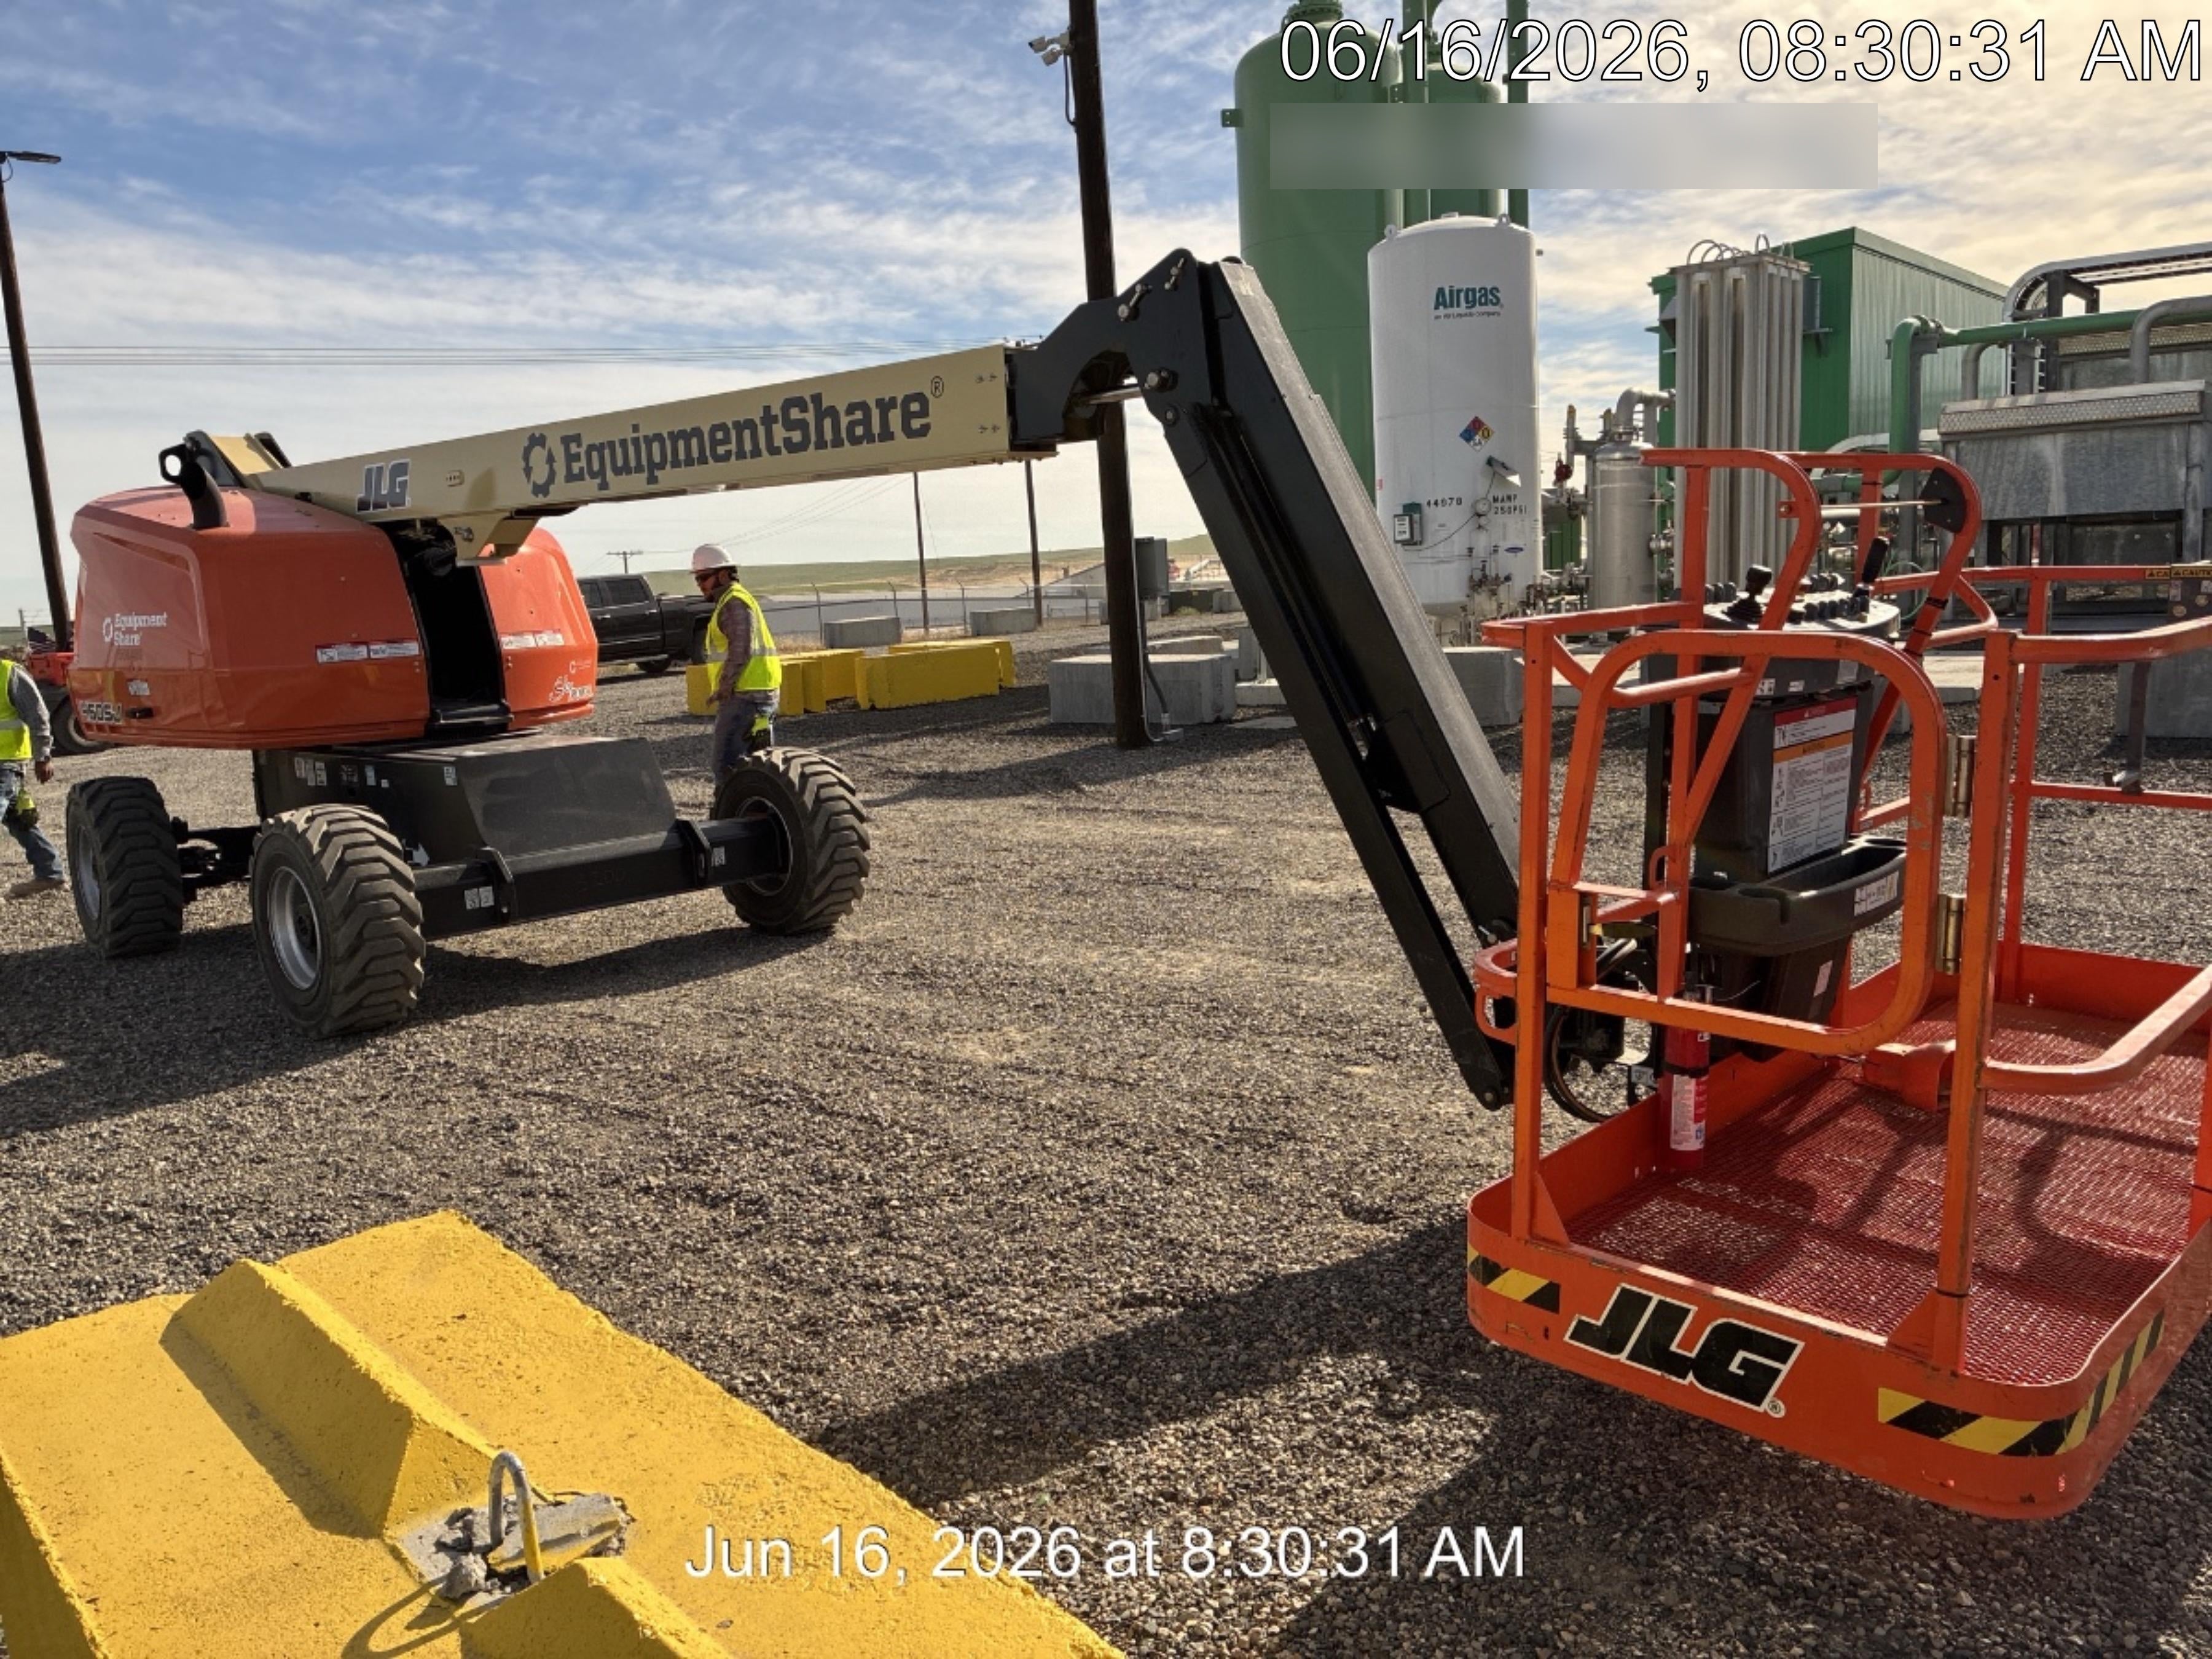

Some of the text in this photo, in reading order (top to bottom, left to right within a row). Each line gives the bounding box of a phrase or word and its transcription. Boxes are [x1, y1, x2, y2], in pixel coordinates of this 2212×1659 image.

[1434, 286, 1501, 310] Airgas
[560, 392, 931, 490] EquipmentShare
[356, 459, 411, 514] JLG
[114, 612, 167, 630] Equipment
[114, 632, 141, 645] Share
[1564, 1283, 1805, 1413] JLG
